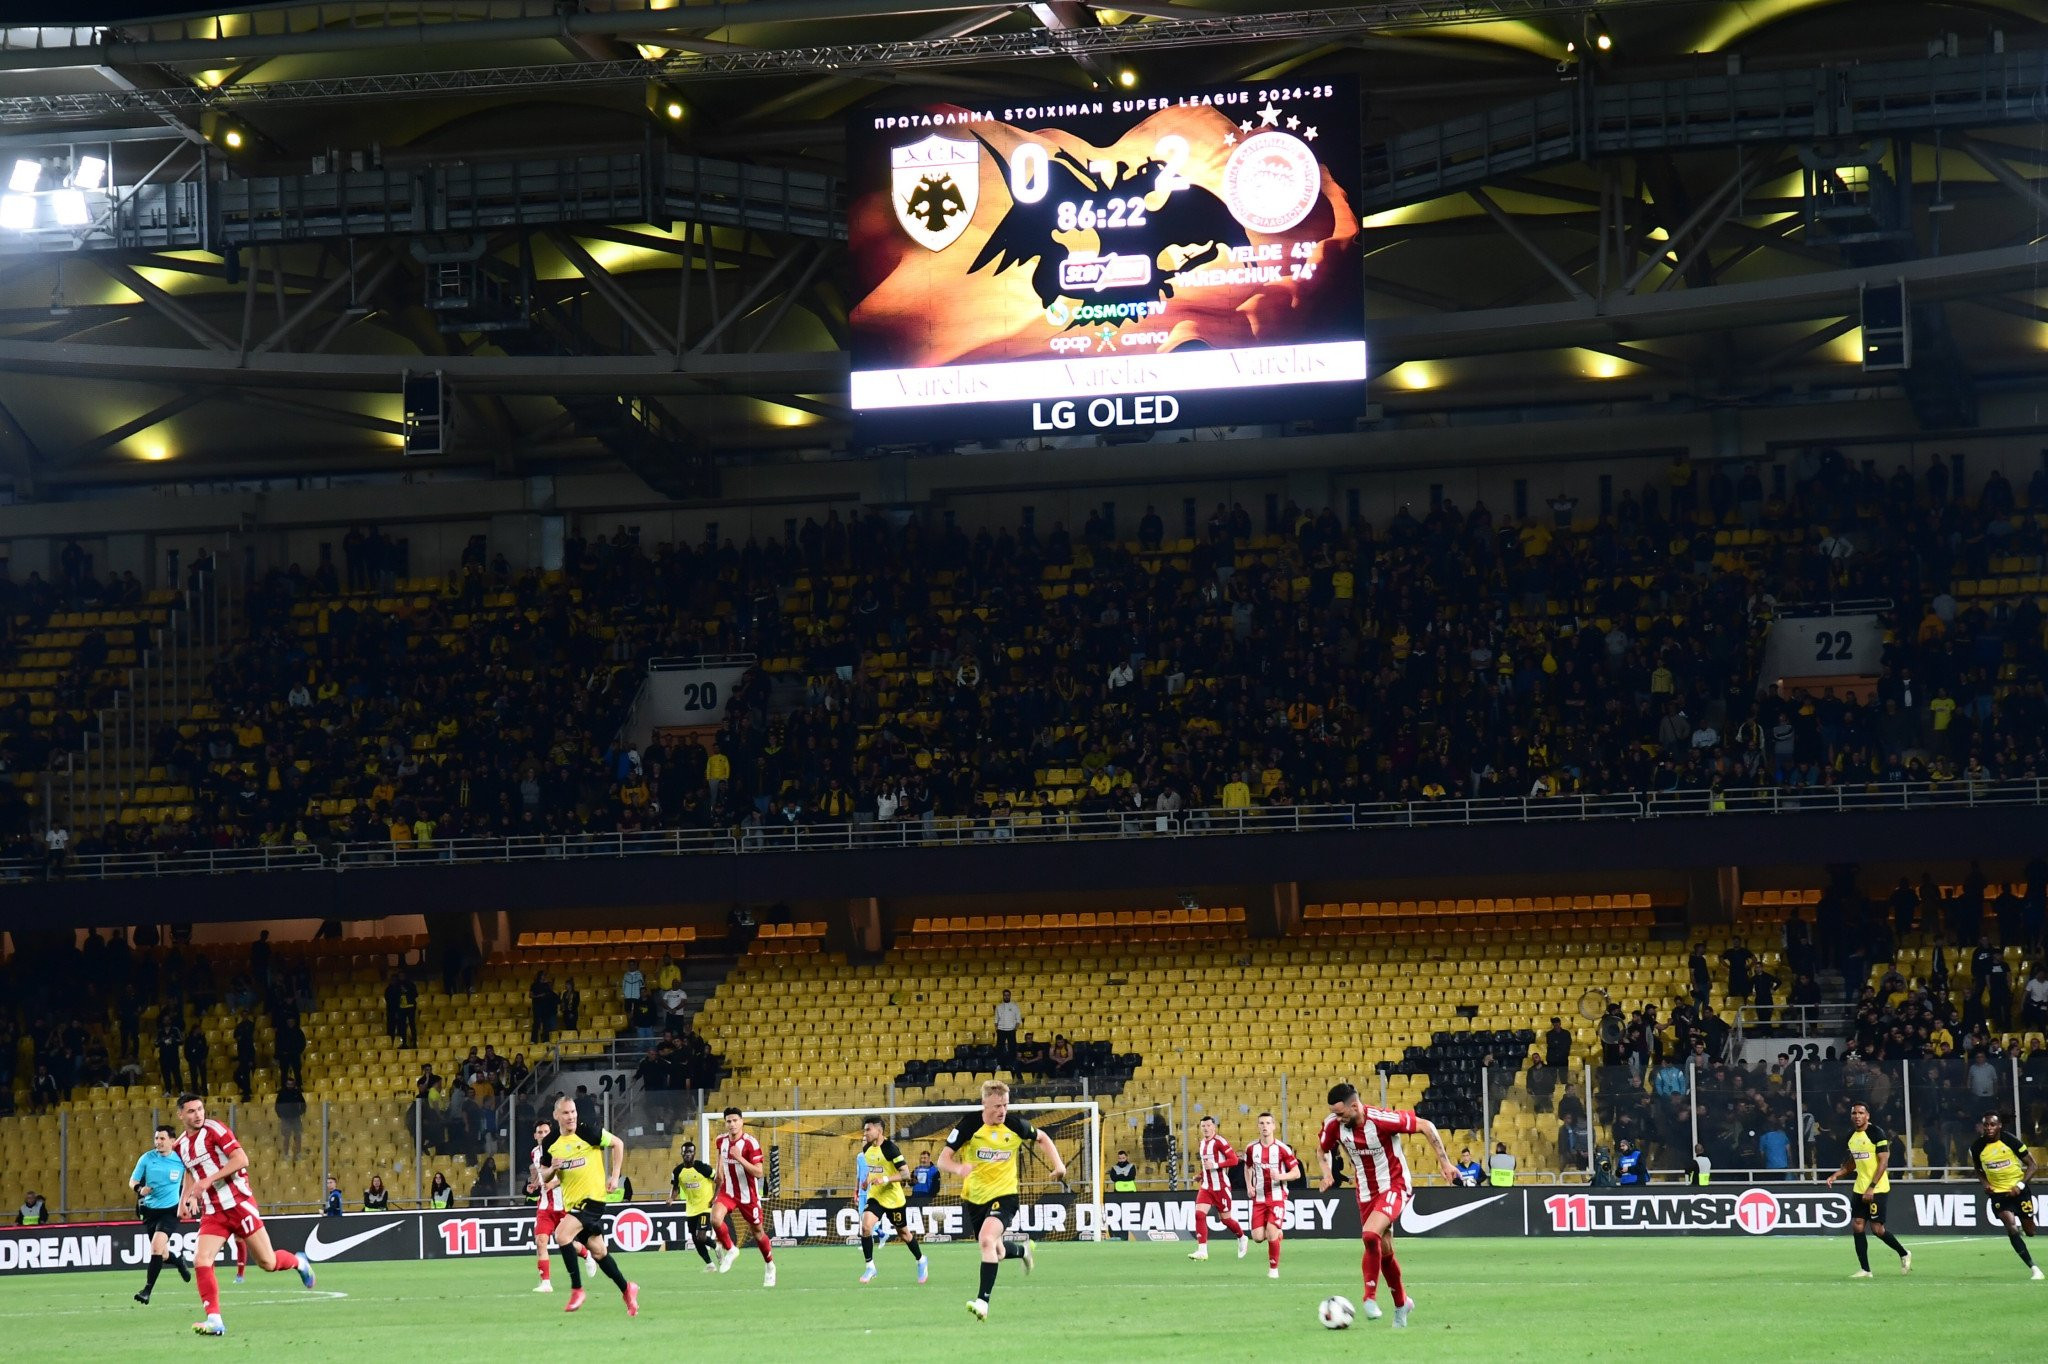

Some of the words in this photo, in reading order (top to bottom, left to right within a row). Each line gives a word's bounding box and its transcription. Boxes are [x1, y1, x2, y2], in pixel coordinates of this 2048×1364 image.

[875, 111, 995, 129] ΠΡΩΤΑΘΛΗΜΑ
[1004, 102, 1103, 121] STOIXIMAN
[1112, 98, 1170, 113] SUPER
[1178, 91, 1249, 108] LEAGUE
[1258, 85, 1333, 102] 2024-25
[1011, 143, 1048, 204] 0
[1155, 135, 1190, 191] 2
[1057, 197, 1146, 231] 86:22
[1227, 243, 1282, 262] VELDE
[1121, 331, 1169, 346] arena
[1033, 402, 1076, 431] LG
[1087, 395, 1180, 427] OLED
[1816, 631, 1853, 660] 22
[684, 681, 717, 710] 20
[599, 1075, 626, 1099] 21
[1221, 1198, 1229, 1210] 4
[1386, 1190, 1398, 1206] 11
[1914, 1194, 1977, 1227] WE
[240, 1215, 255, 1235] 17
[700, 1215, 708, 1225] 11
[752, 1207, 760, 1220] 8
[772, 1208, 828, 1237] WE
[1076, 1201, 1196, 1231] DREAM
[892, 1212, 902, 1222] 13
[0, 1234, 112, 1270] DREAM
